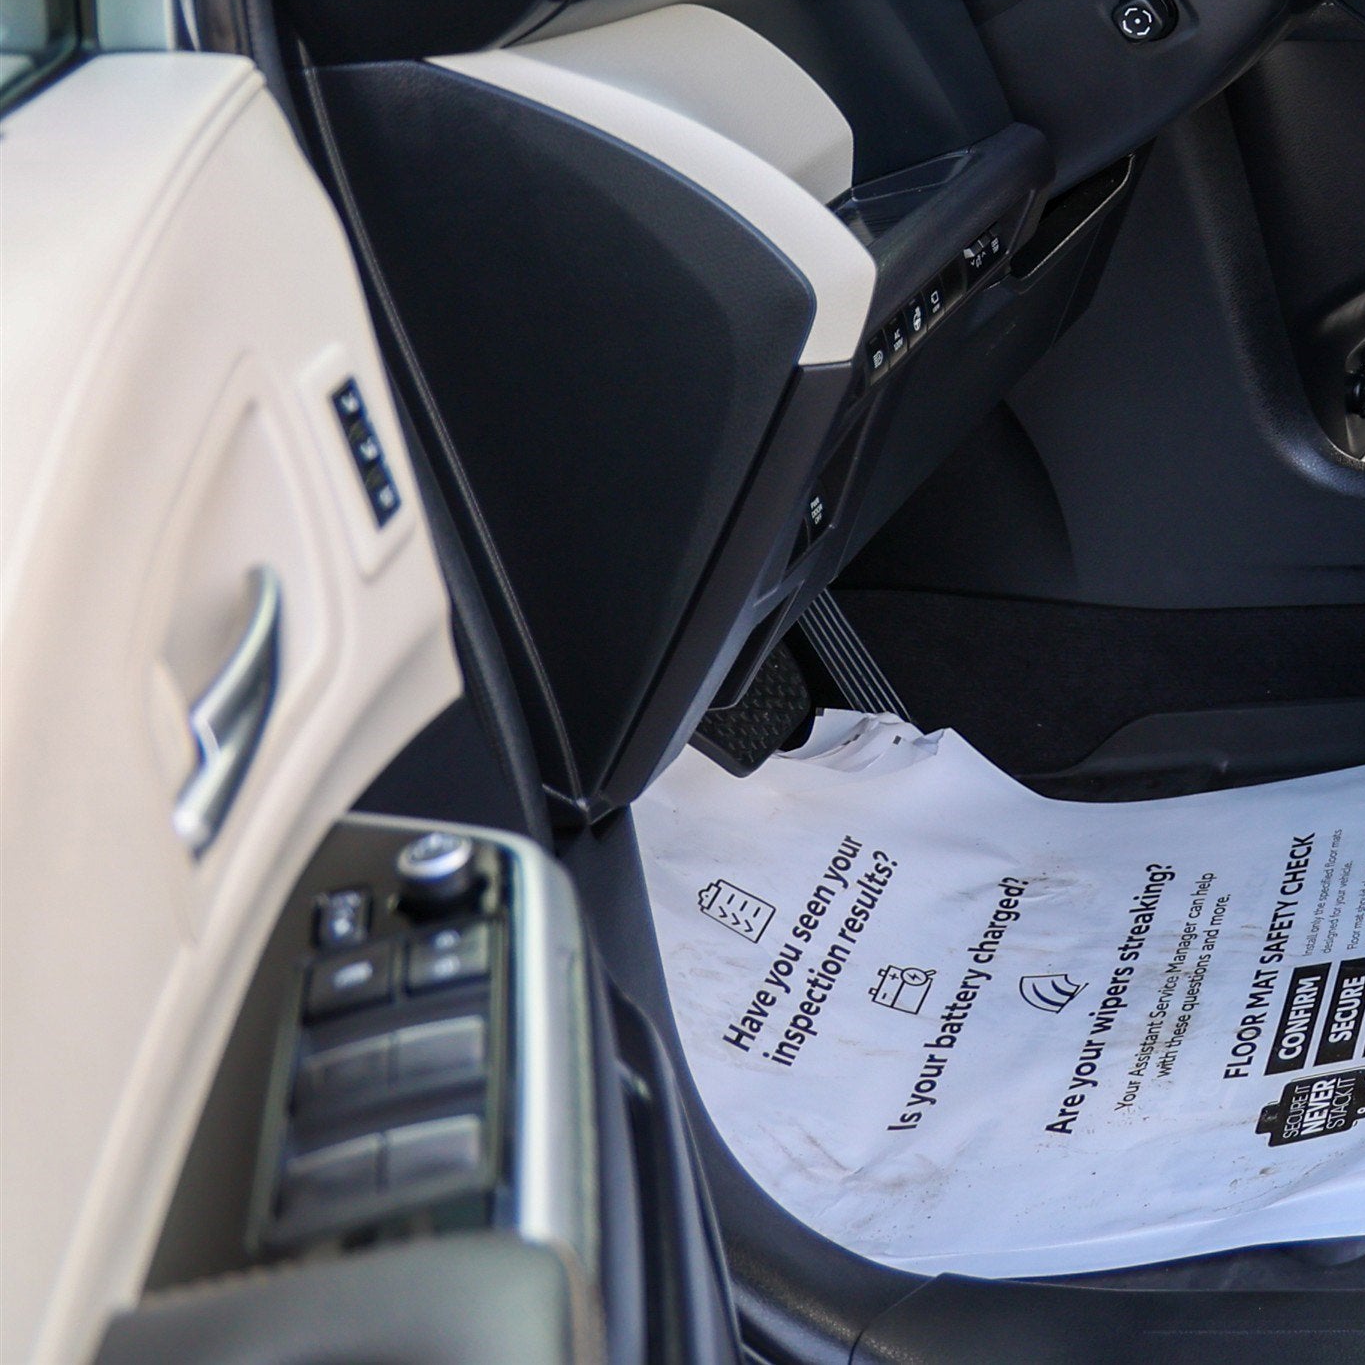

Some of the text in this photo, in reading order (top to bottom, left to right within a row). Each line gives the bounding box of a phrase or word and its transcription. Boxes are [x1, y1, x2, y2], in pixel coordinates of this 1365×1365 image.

[723, 835, 862, 1052] Have you seen your
[763, 851, 898, 1066] inspection results?
[887, 877, 1029, 1130] Is your battery charged?
[1045, 864, 1175, 1134] Are your wipers streaking?
[1114, 873, 1216, 1110] Your Assistant Service Manager can help
[1156, 894, 1231, 1077] with these questions and more.
[1223, 833, 1315, 1079] FLOOR MAT SAFETY CHECK
[1278, 976, 1321, 1060] CONFIRM
[1328, 976, 1365, 1042] SECURE
[1282, 1085, 1310, 1138] SECURE IT
[1300, 1078, 1336, 1135] NEVER
[1326, 1078, 1356, 1128] STACK IT
